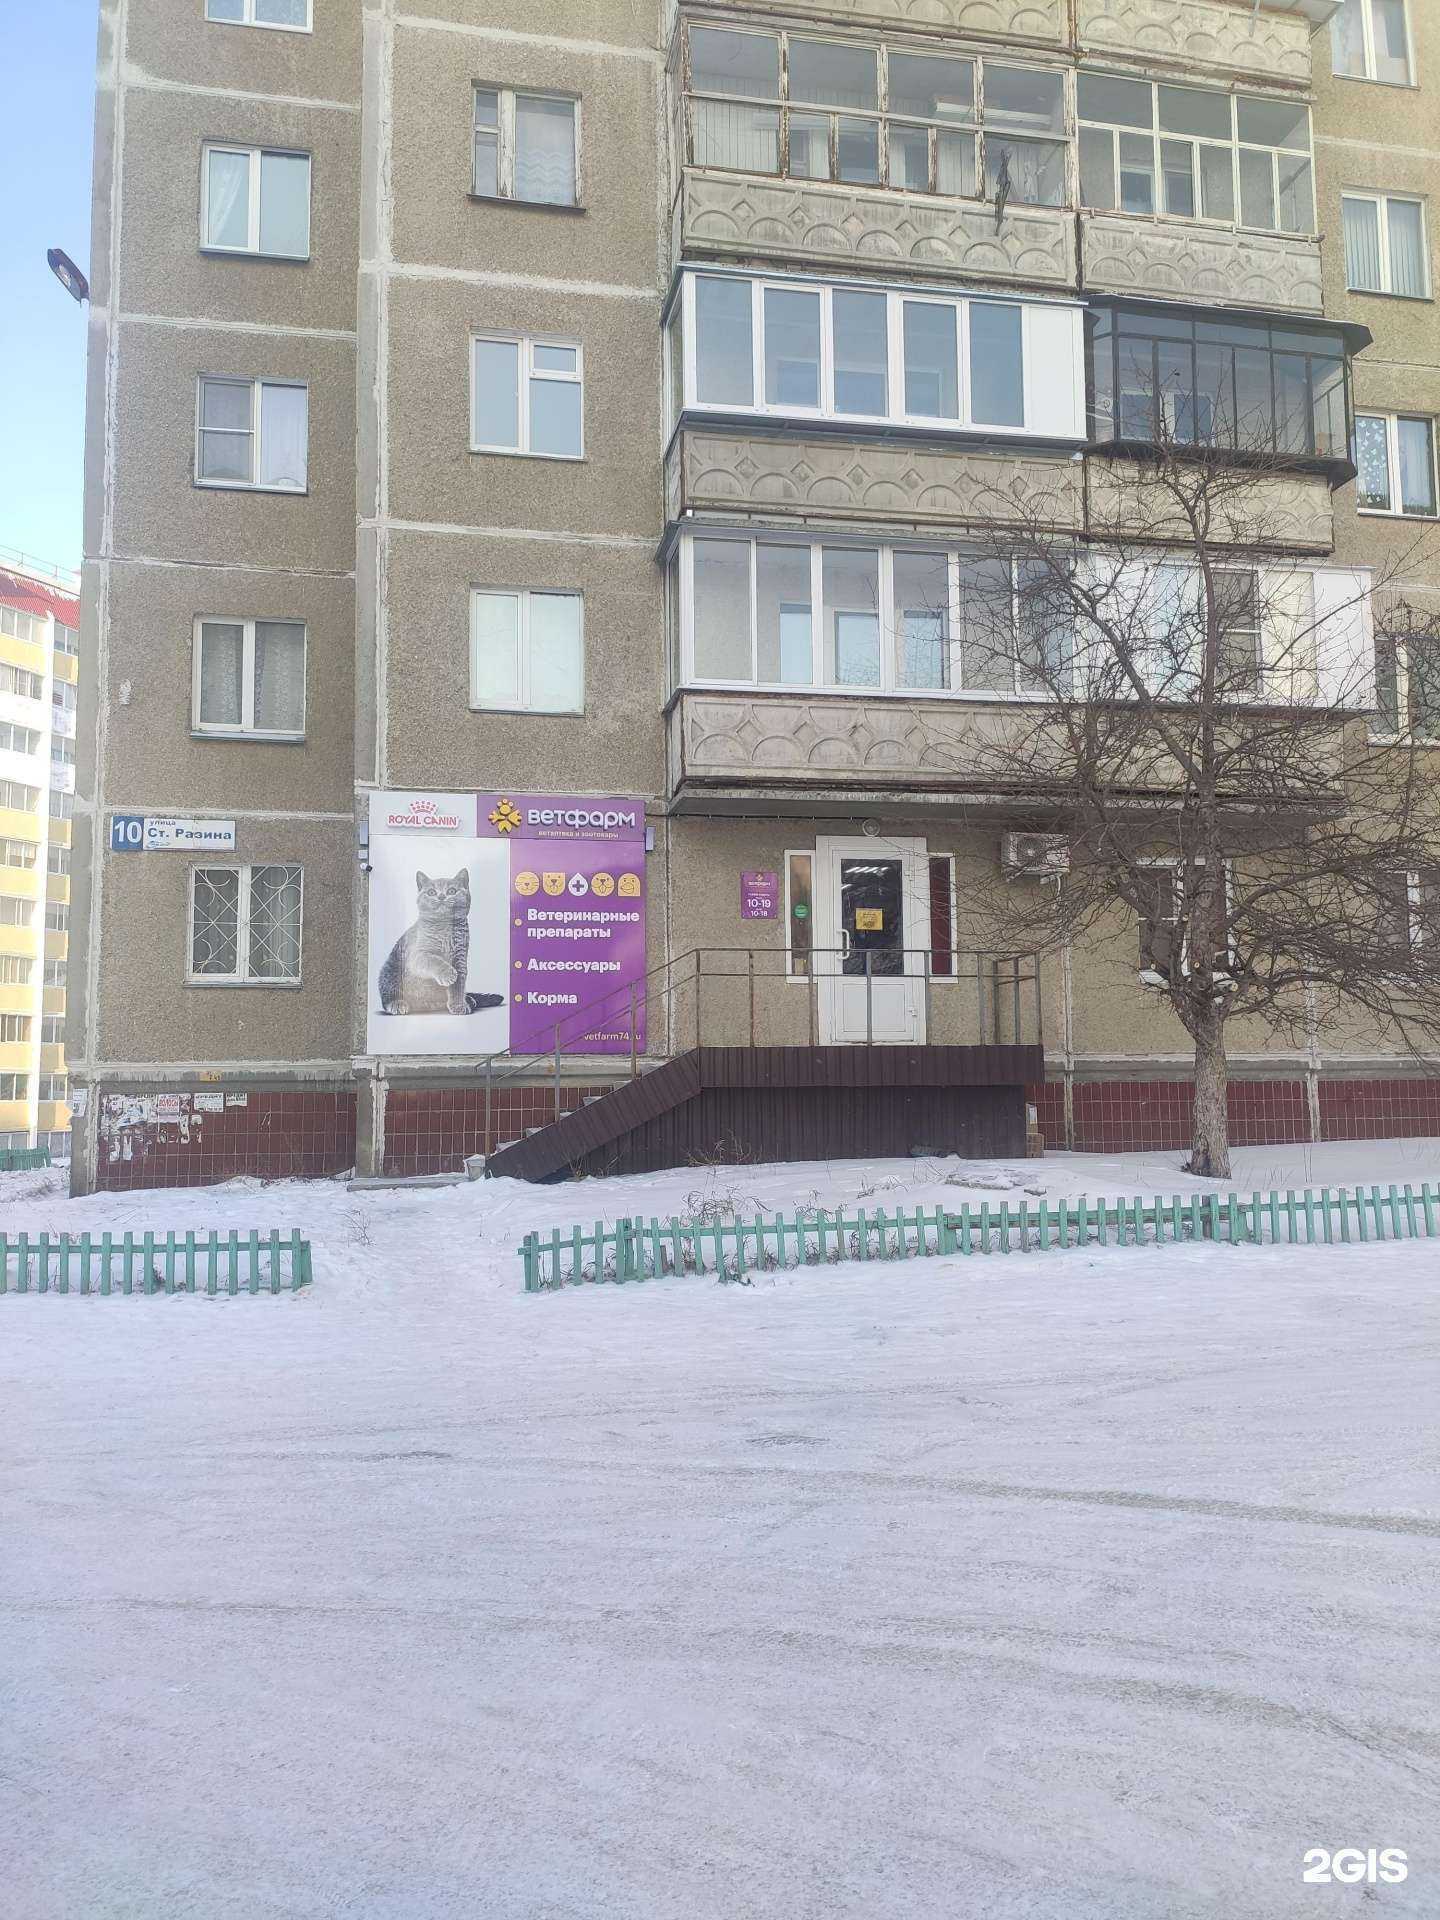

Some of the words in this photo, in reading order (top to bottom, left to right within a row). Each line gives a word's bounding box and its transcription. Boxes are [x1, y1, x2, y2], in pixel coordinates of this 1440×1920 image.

[388, 815, 421, 825] ROYAL
[424, 816, 457, 826] CANIN
[114, 821, 142, 843] 10
[148, 828, 170, 838] Ст.
[176, 829, 232, 840] Разина
[747, 899, 771, 908] 10-19
[527, 908, 640, 923] Ветеринарные
[527, 927, 611, 940] препараты
[527, 958, 621, 973] Аксессуары
[527, 991, 578, 1006] Корма
[584, 1032, 641, 1040] vetfarm74.u
